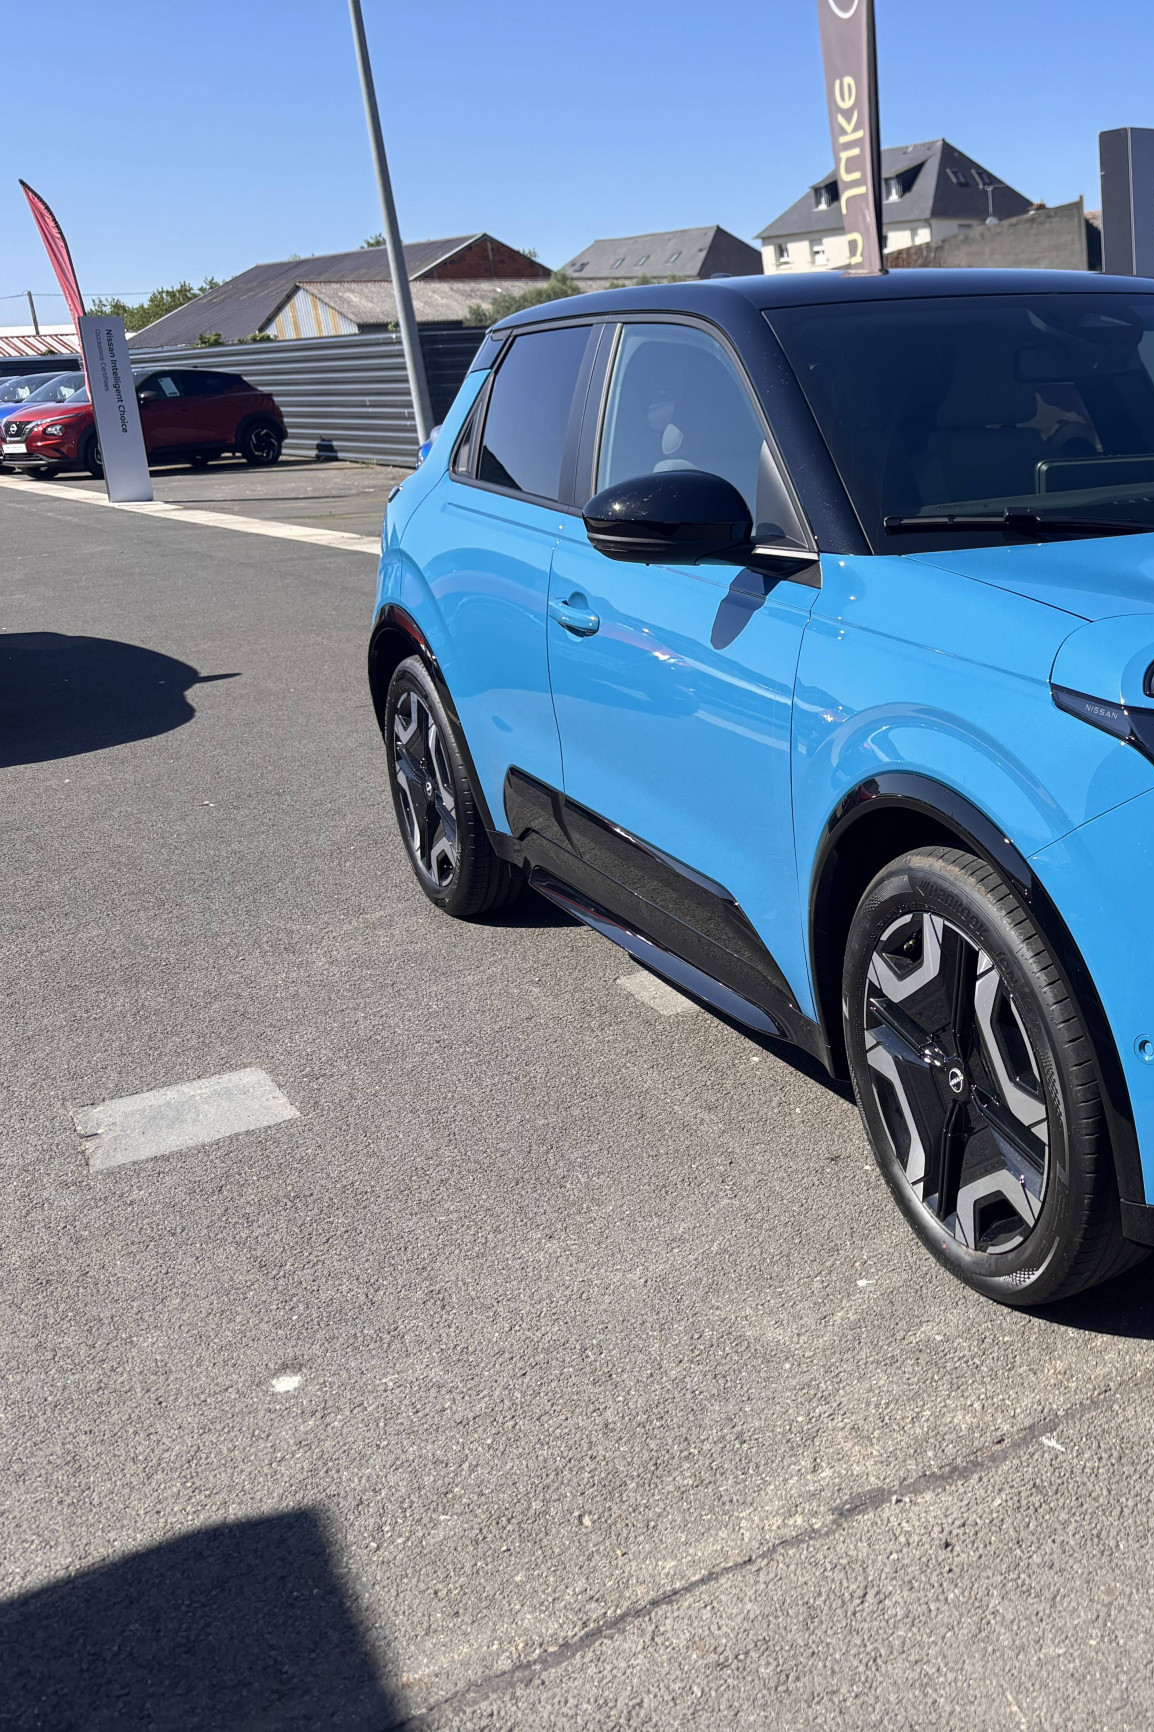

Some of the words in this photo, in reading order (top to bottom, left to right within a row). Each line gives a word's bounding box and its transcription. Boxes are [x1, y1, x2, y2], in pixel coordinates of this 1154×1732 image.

[95, 328, 104, 361] Occasions
[105, 328, 116, 358] Nissan
[110, 359, 123, 403] Intelligent
[118, 404, 129, 433] Choice
[1084, 703, 1118, 720] NISSAN
